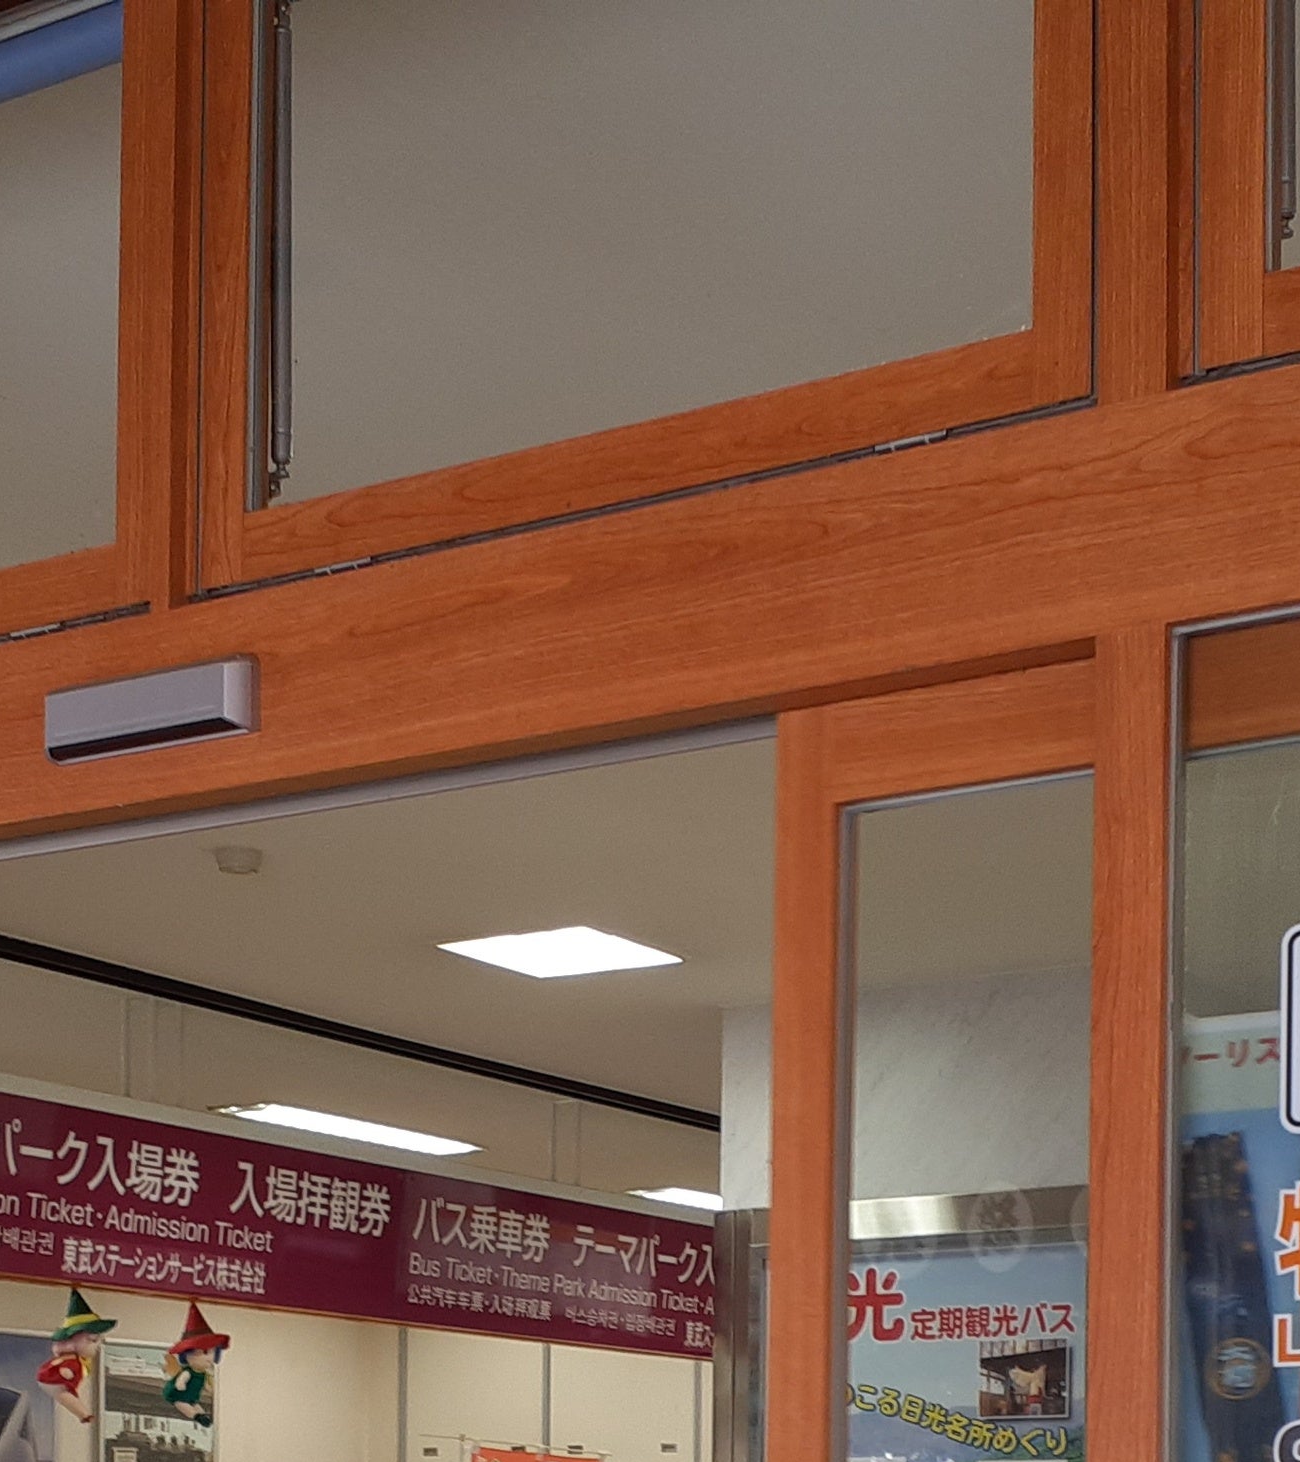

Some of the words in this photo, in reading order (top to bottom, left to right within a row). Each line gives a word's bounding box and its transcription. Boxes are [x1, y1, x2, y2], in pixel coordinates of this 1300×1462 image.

[1182, 1037, 1280, 1069] ーリス
[229, 1161, 391, 1239] 入場拝観券
[214, 1220, 274, 1254] Ticket
[412, 1197, 551, 1264] バス乗車券
[572, 1224, 716, 1288] テーマパーク入
[61, 1238, 267, 1296] 東武ステーションサービス株式会社
[408, 1252, 442, 1278] Bus
[552, 1273, 586, 1299] Park
[587, 1279, 657, 1308] Admission
[910, 1303, 1075, 1341] 定期観光バス
[845, 1384, 1067, 1457] こる日光名所めぐり
